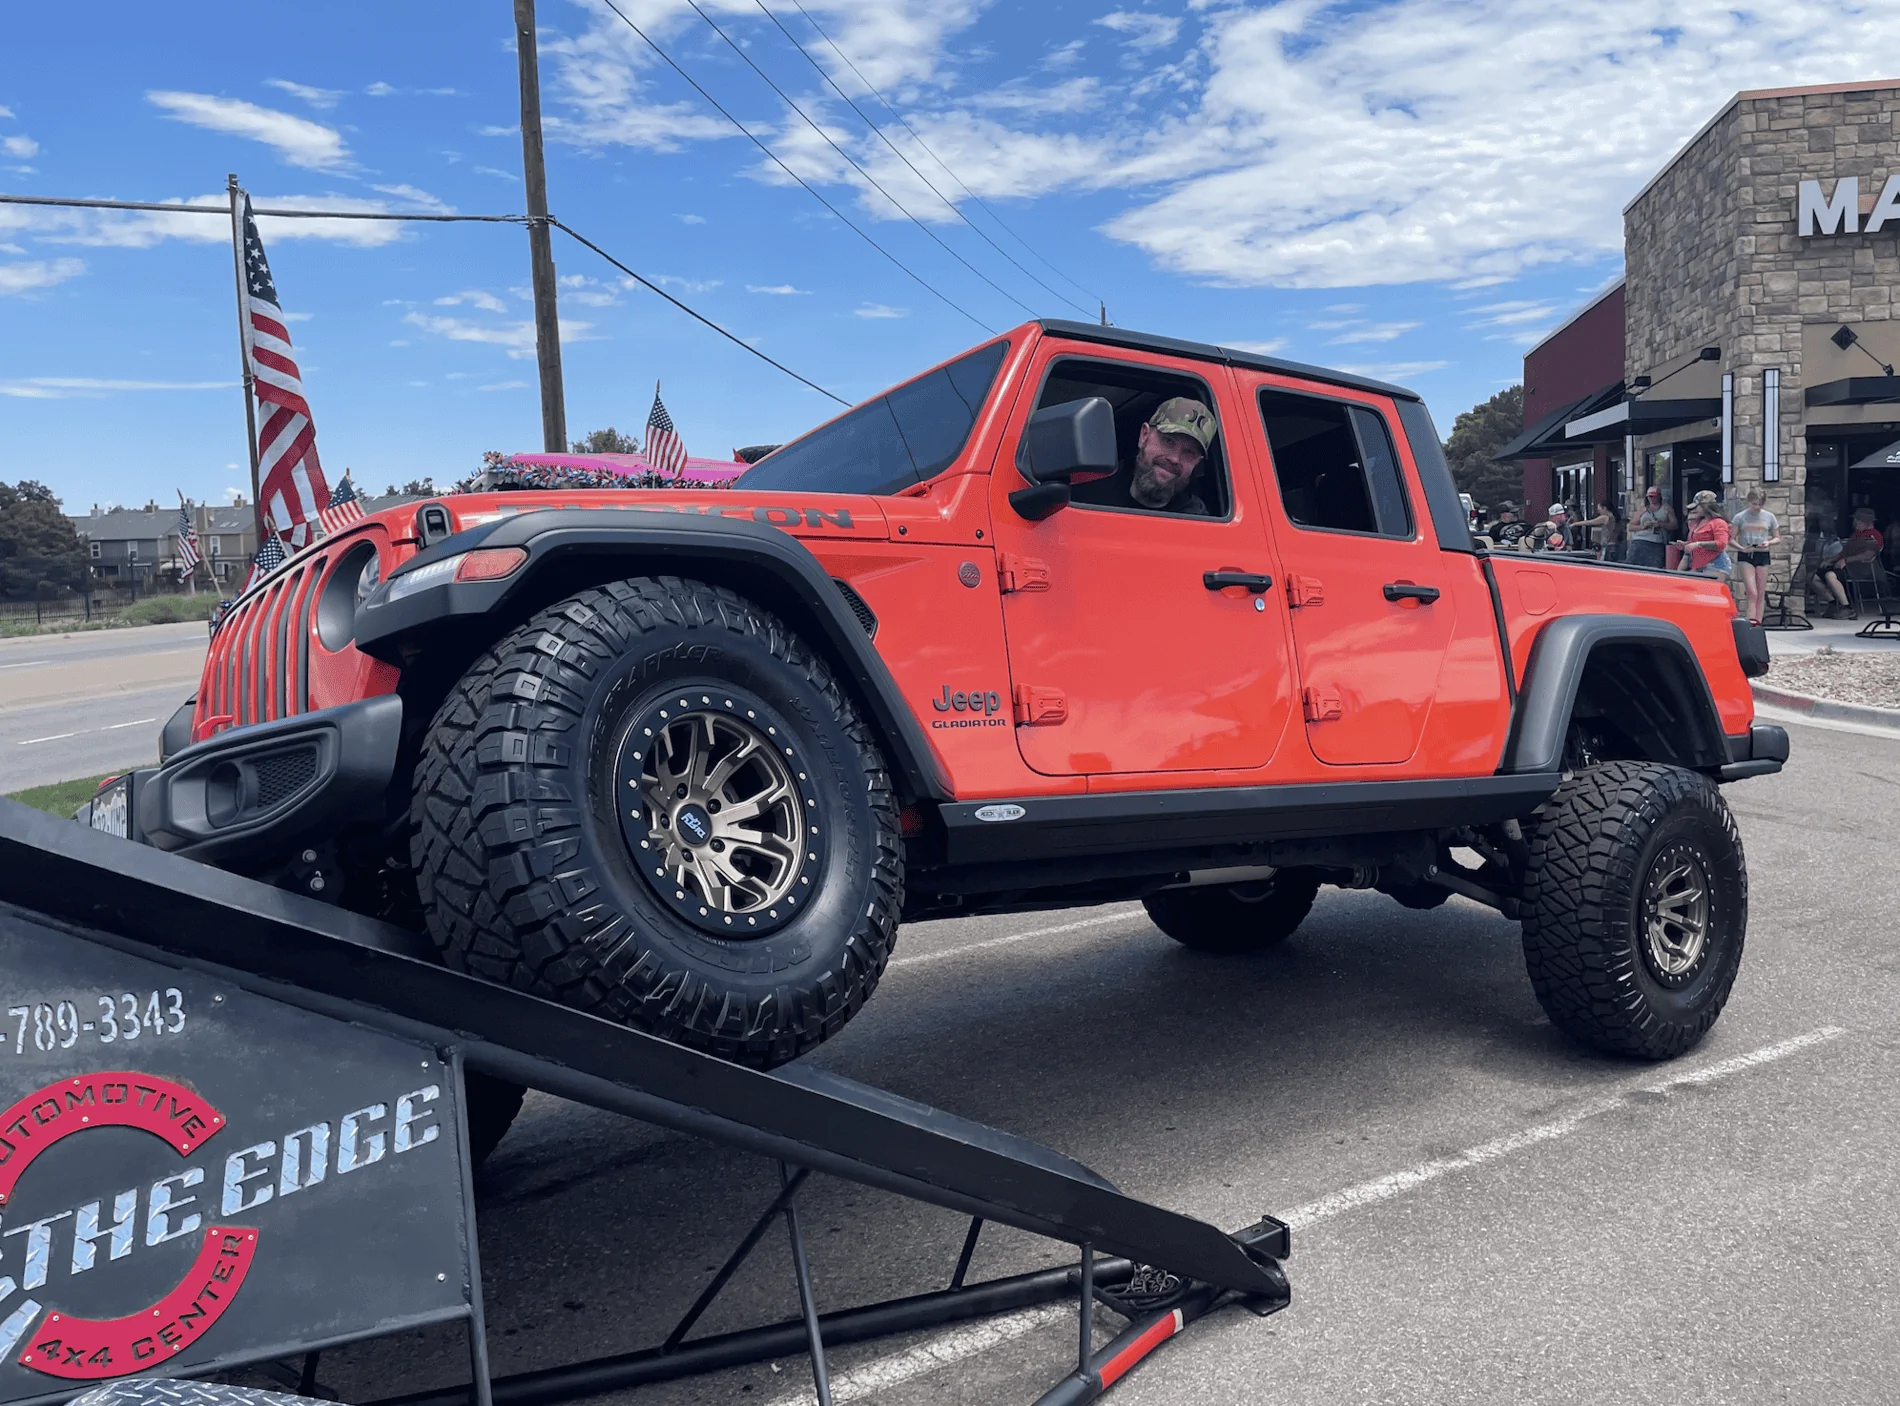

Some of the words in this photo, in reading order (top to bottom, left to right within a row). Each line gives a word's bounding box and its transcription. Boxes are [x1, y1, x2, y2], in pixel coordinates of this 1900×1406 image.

[931, 718, 1007, 729] GLADIATOR
[932, 685, 1001, 716] Jeep
[3, 1167, 204, 1291] THE
[131, 1234, 244, 1361] CENTER
